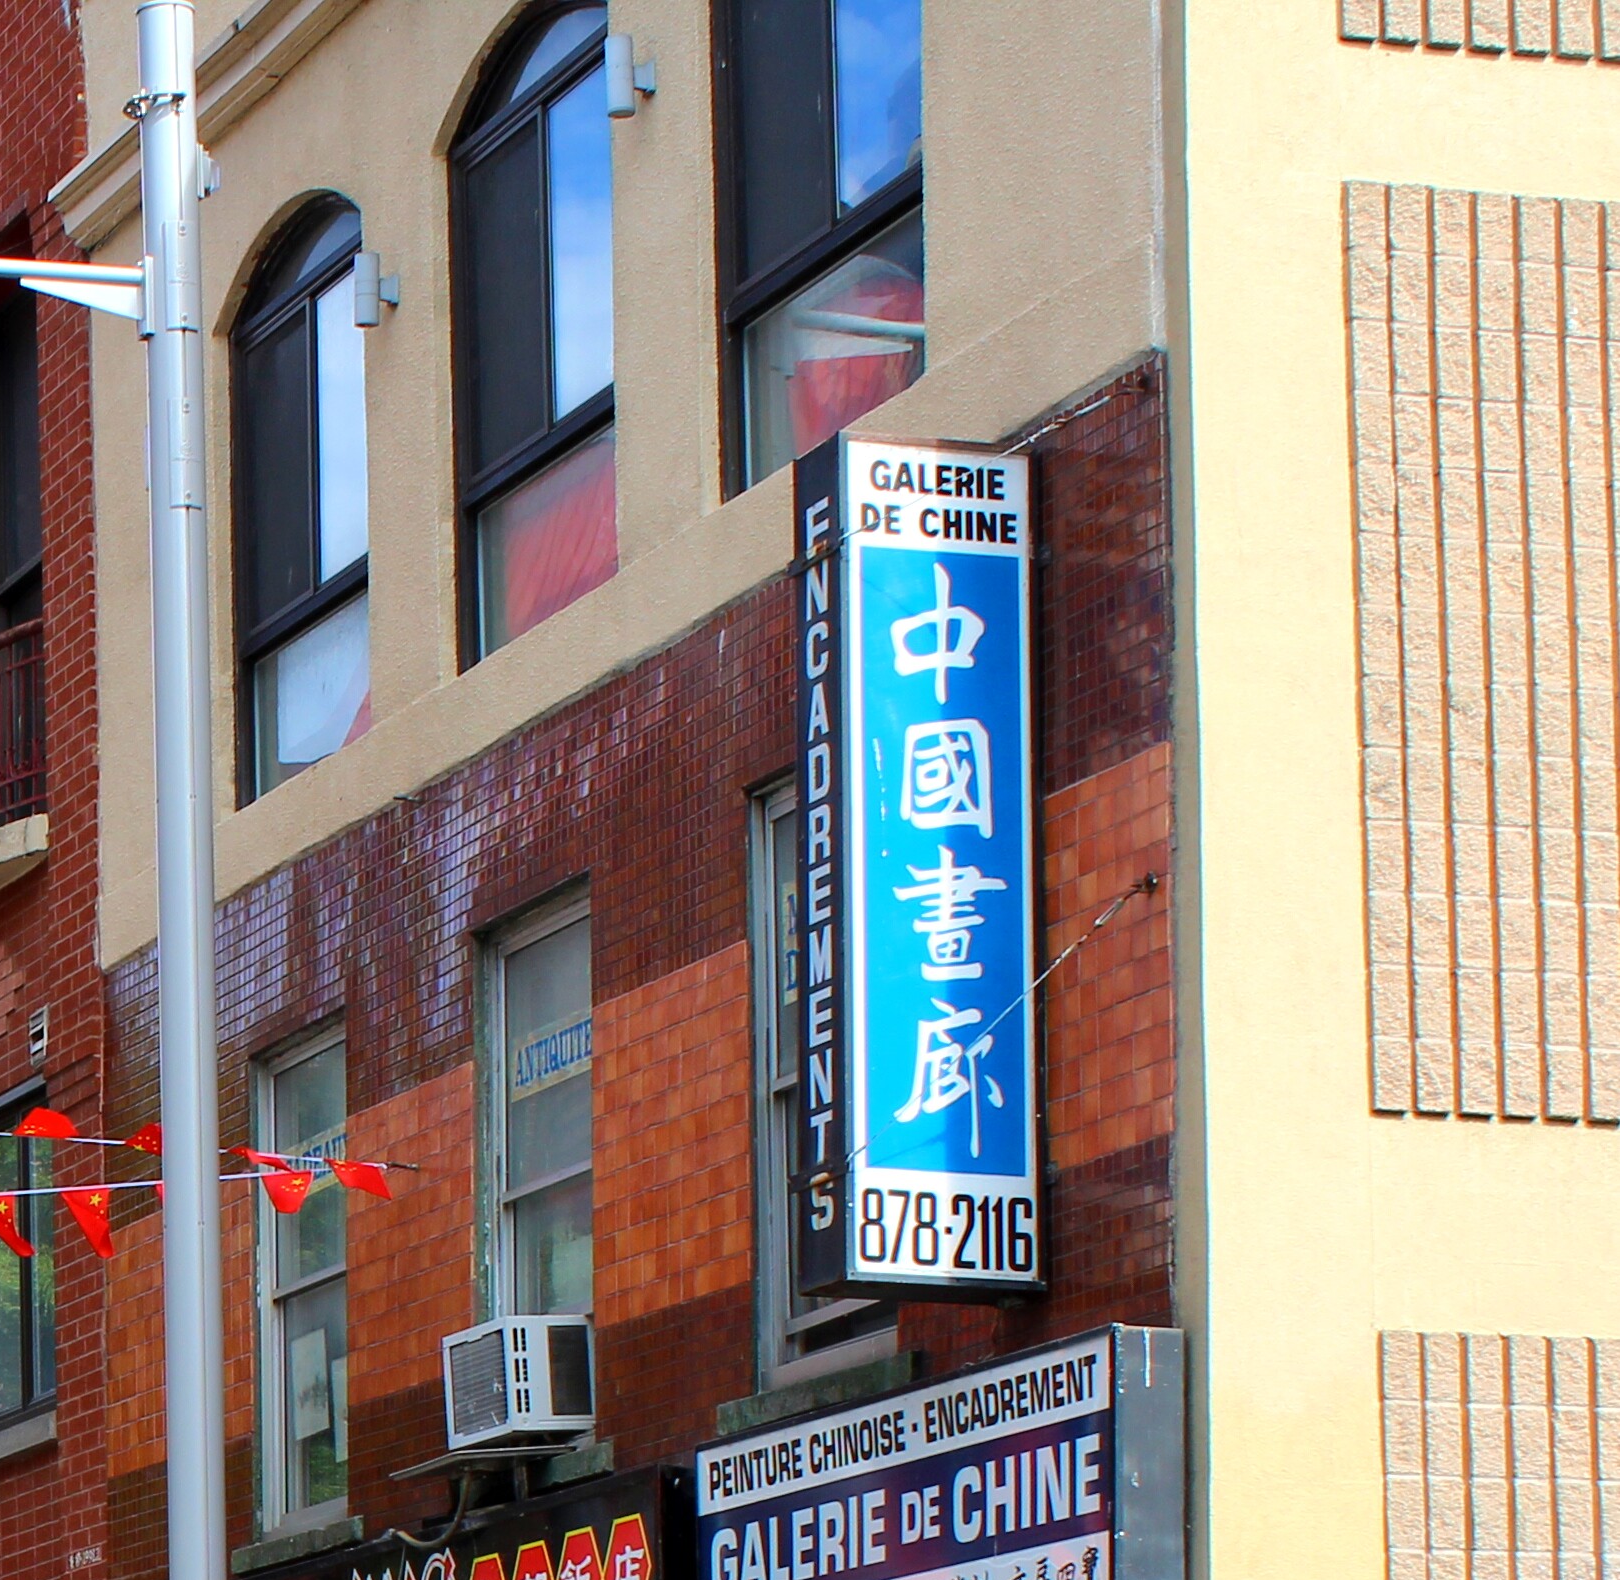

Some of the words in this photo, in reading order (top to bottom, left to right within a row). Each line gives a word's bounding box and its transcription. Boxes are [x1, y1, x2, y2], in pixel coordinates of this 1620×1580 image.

[860, 503, 902, 536] DE
[919, 506, 1018, 544] CHINE
[869, 459, 1006, 501] GALERIE
[804, 498, 834, 1232] ENCADREMENTS
[890, 562, 1009, 1159] 中國畫廊
[859, 1187, 1034, 1274] 878-2116
[709, 1438, 801, 1501] PEINTURE
[809, 1410, 906, 1475] CHINOISE
[924, 1353, 1098, 1444] ENCADREMENT
[900, 1484, 940, 1545] DE
[952, 1432, 1101, 1544] CHINE
